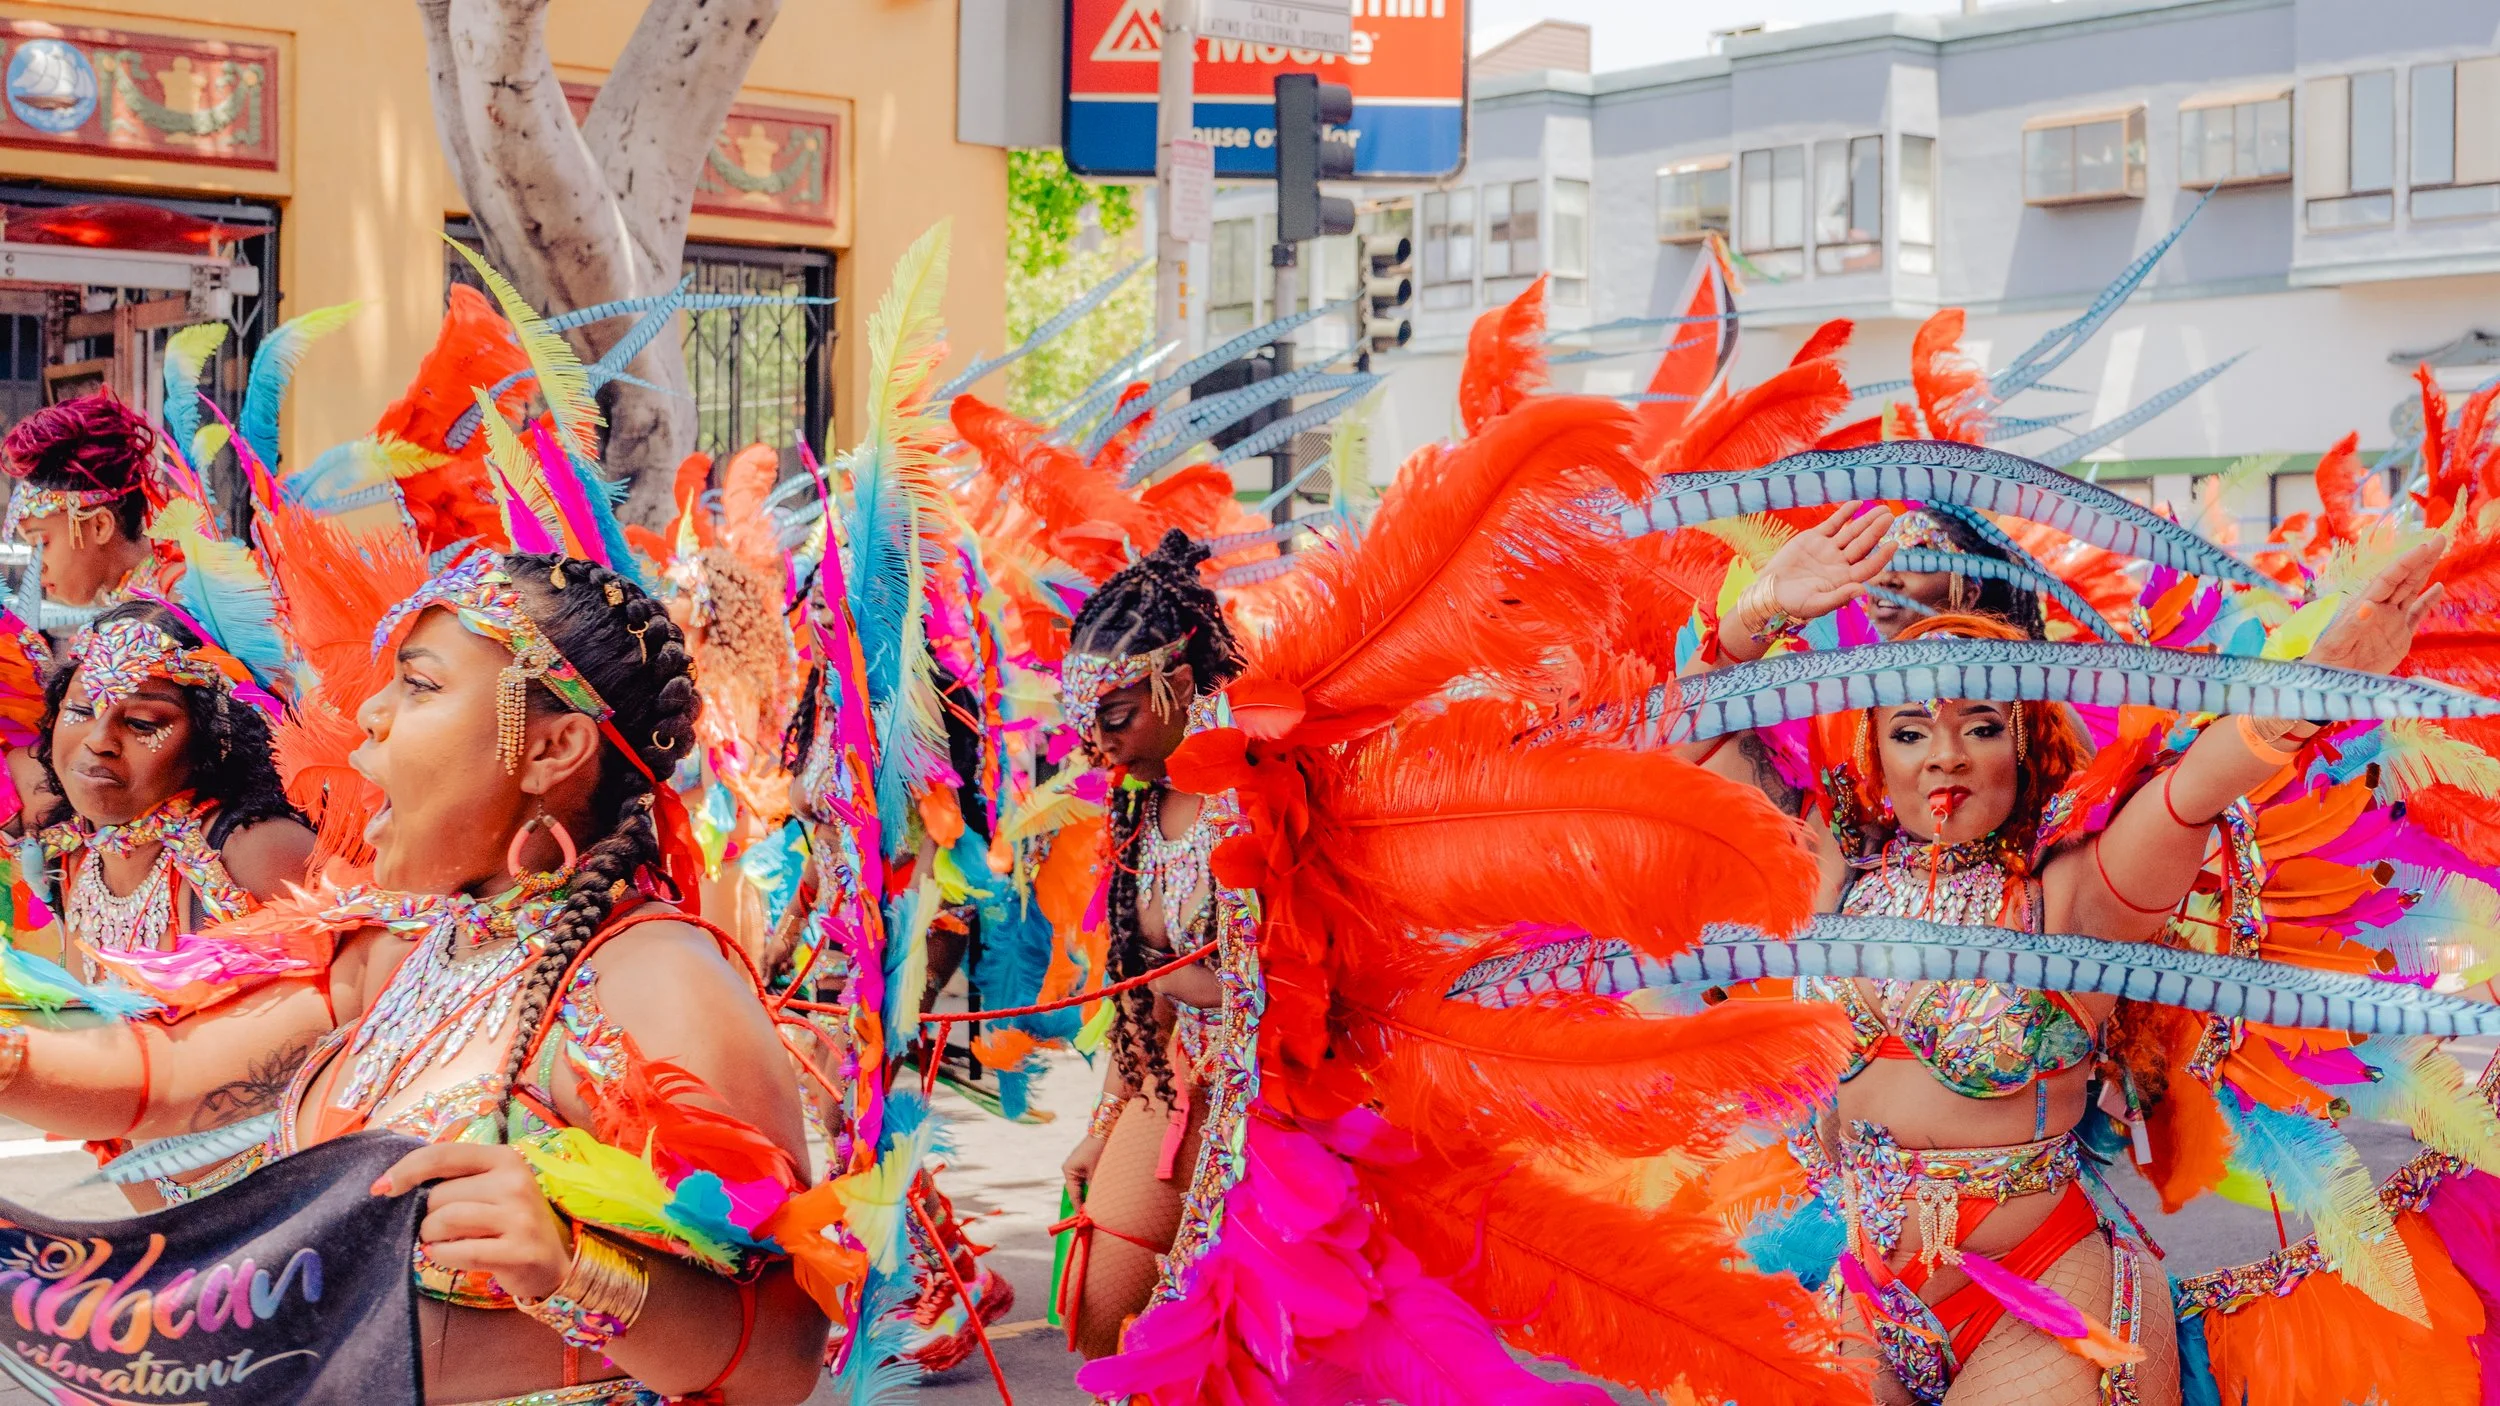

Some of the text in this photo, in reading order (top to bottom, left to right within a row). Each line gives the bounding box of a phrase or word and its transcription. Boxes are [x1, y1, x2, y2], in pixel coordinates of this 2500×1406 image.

[1251, 5, 1283, 23] CALLE
[1245, 22, 1296, 43] CULTURAL
[1301, 30, 1345, 51] DISTRICT
[1192, 126, 1251, 148] ouse
[1254, 127, 1277, 149] o
[0, 1233, 324, 1355] ibbean
